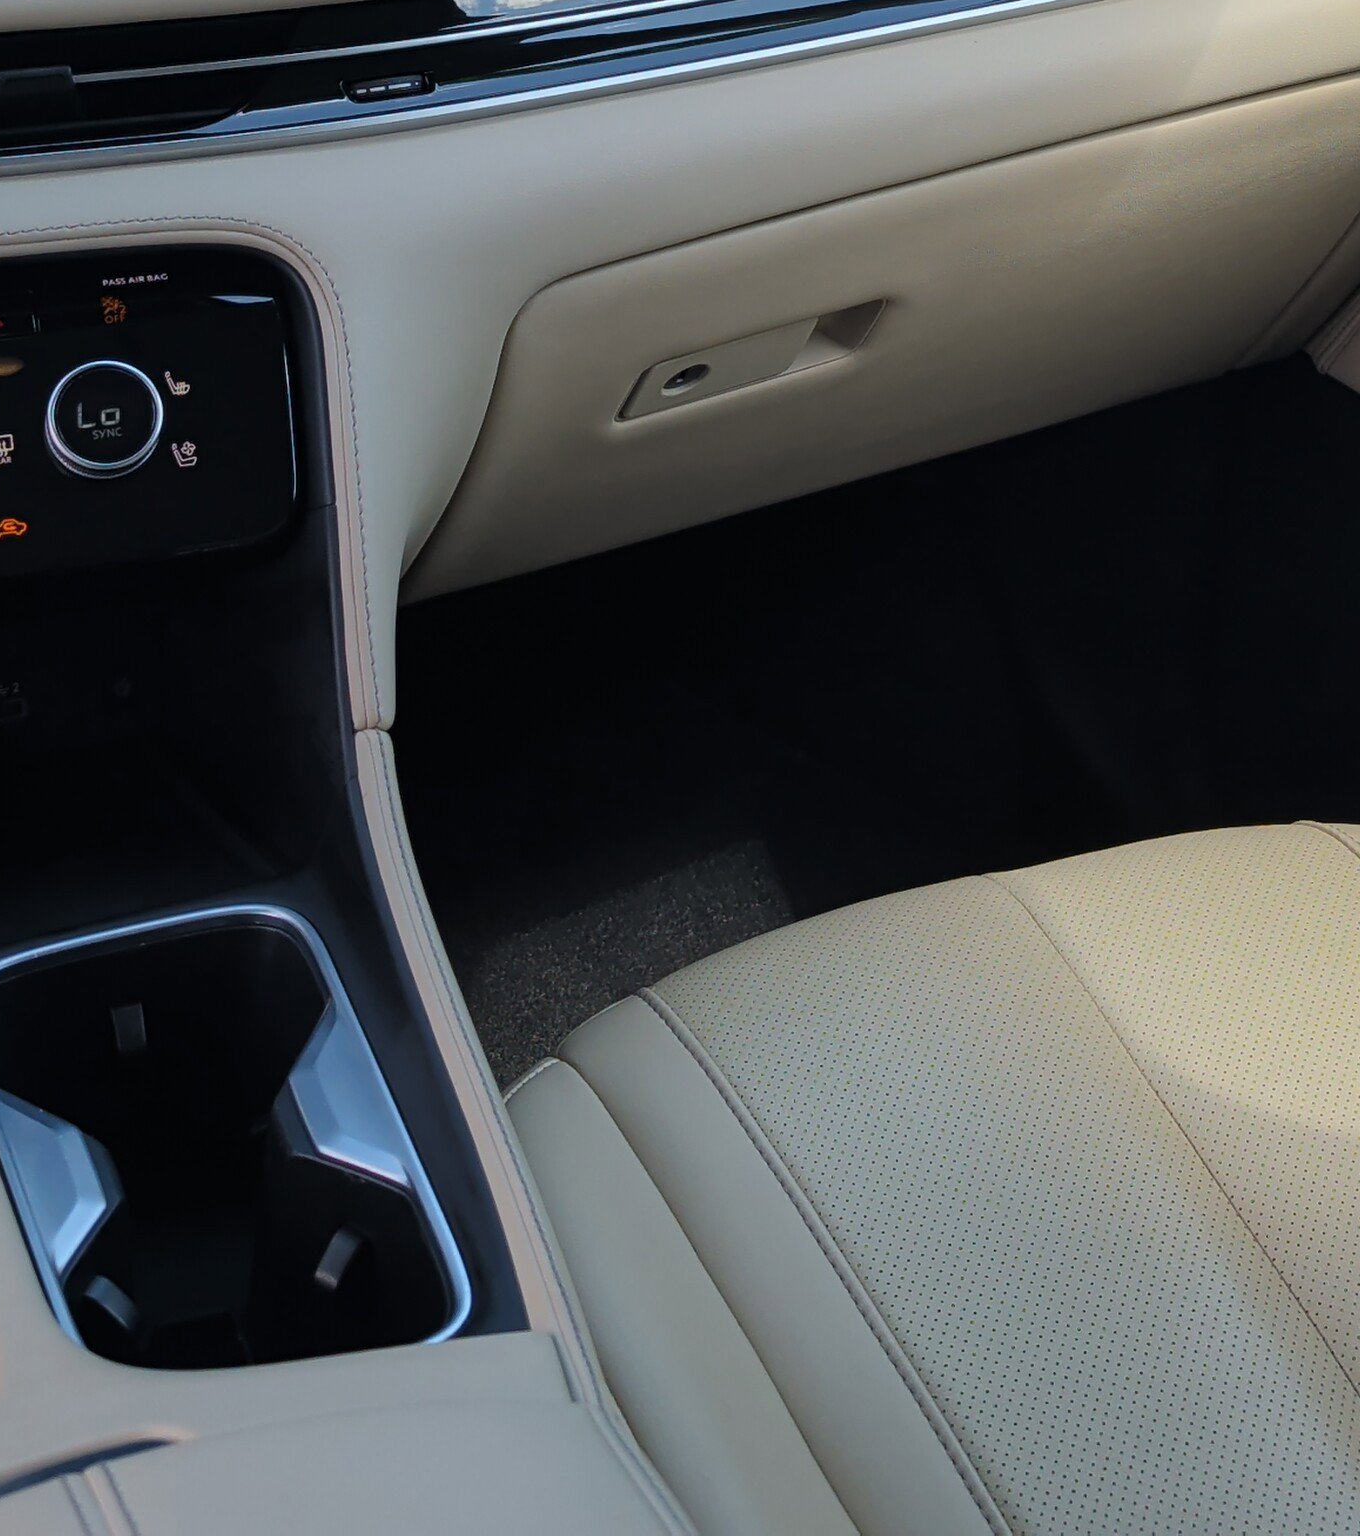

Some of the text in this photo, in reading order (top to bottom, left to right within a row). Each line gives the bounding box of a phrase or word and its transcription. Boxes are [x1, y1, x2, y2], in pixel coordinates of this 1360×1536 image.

[102, 273, 169, 286] PASS AIR BAG
[104, 313, 127, 324] OFF
[92, 426, 123, 440] SYNC
